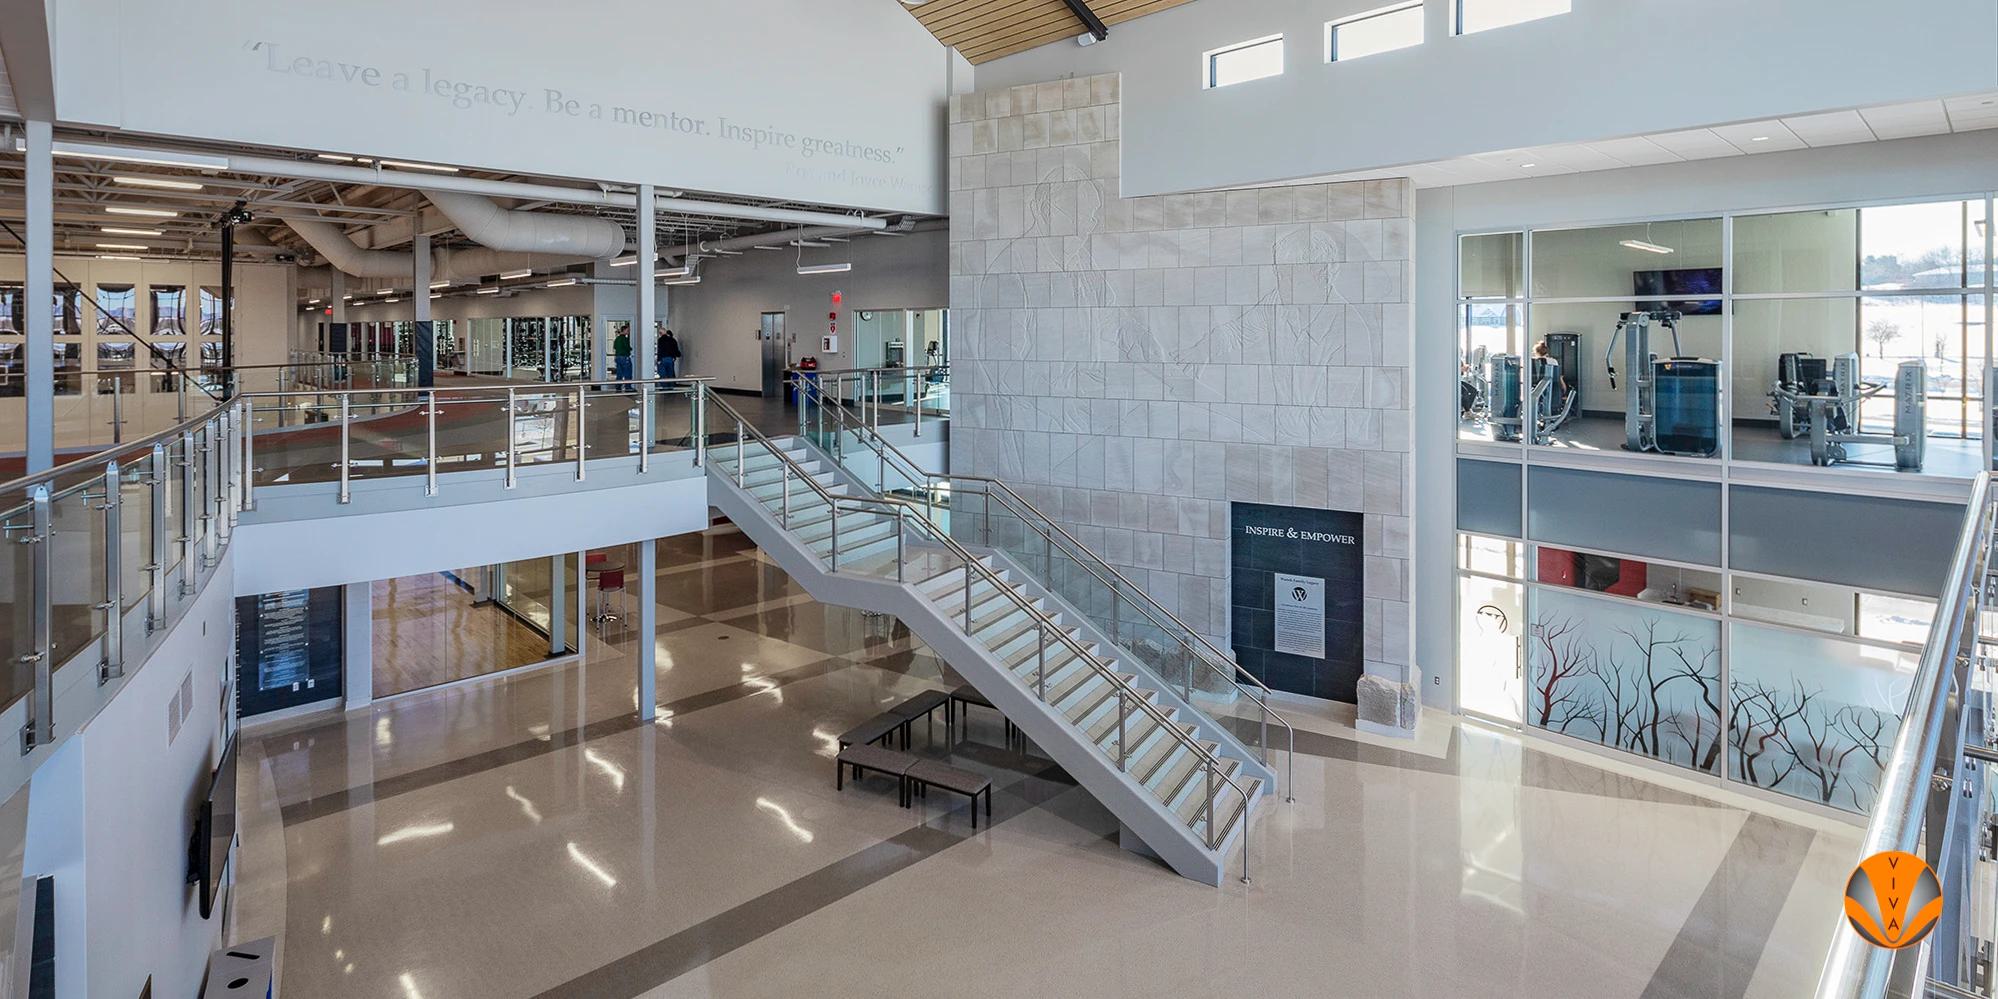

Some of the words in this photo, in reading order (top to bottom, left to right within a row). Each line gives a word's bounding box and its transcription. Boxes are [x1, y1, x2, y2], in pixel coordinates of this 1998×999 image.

[392, 71, 410, 91] a
[422, 68, 534, 117] legacy.
[543, 88, 581, 117] Be
[589, 103, 603, 120] a
[612, 105, 711, 138] mentor.
[719, 117, 796, 150] Inspire
[1904, 371, 1913, 414] MATRIX
[1245, 525, 1285, 538] INSPIRE
[1286, 527, 1298, 539] &
[1300, 531, 1355, 545] EMPOWER
